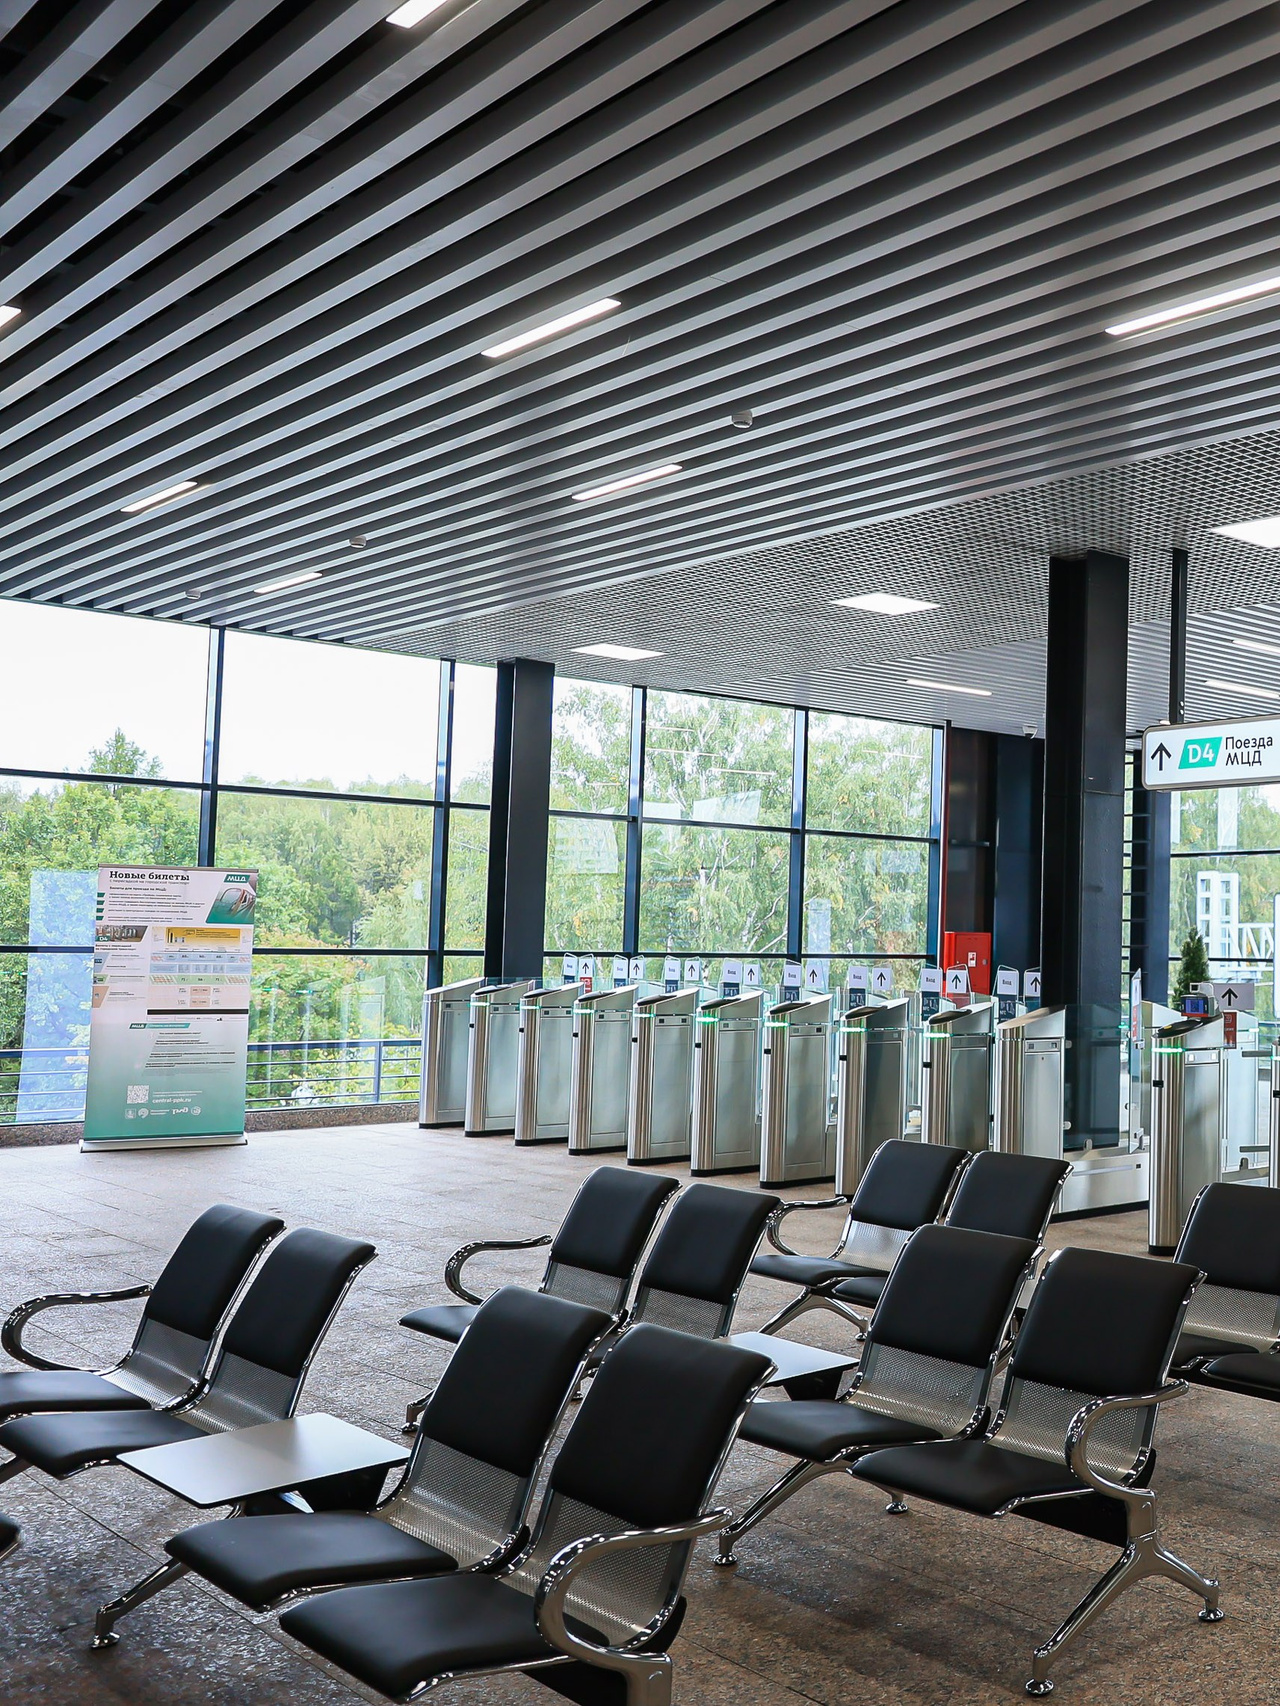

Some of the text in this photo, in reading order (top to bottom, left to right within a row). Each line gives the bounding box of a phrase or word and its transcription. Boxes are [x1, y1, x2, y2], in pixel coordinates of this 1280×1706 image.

[1225, 736, 1273, 750] Поезда
[1187, 743, 1215, 764] D4
[1225, 750, 1262, 767] МЦД
[109, 871, 190, 881] Новые билеты
